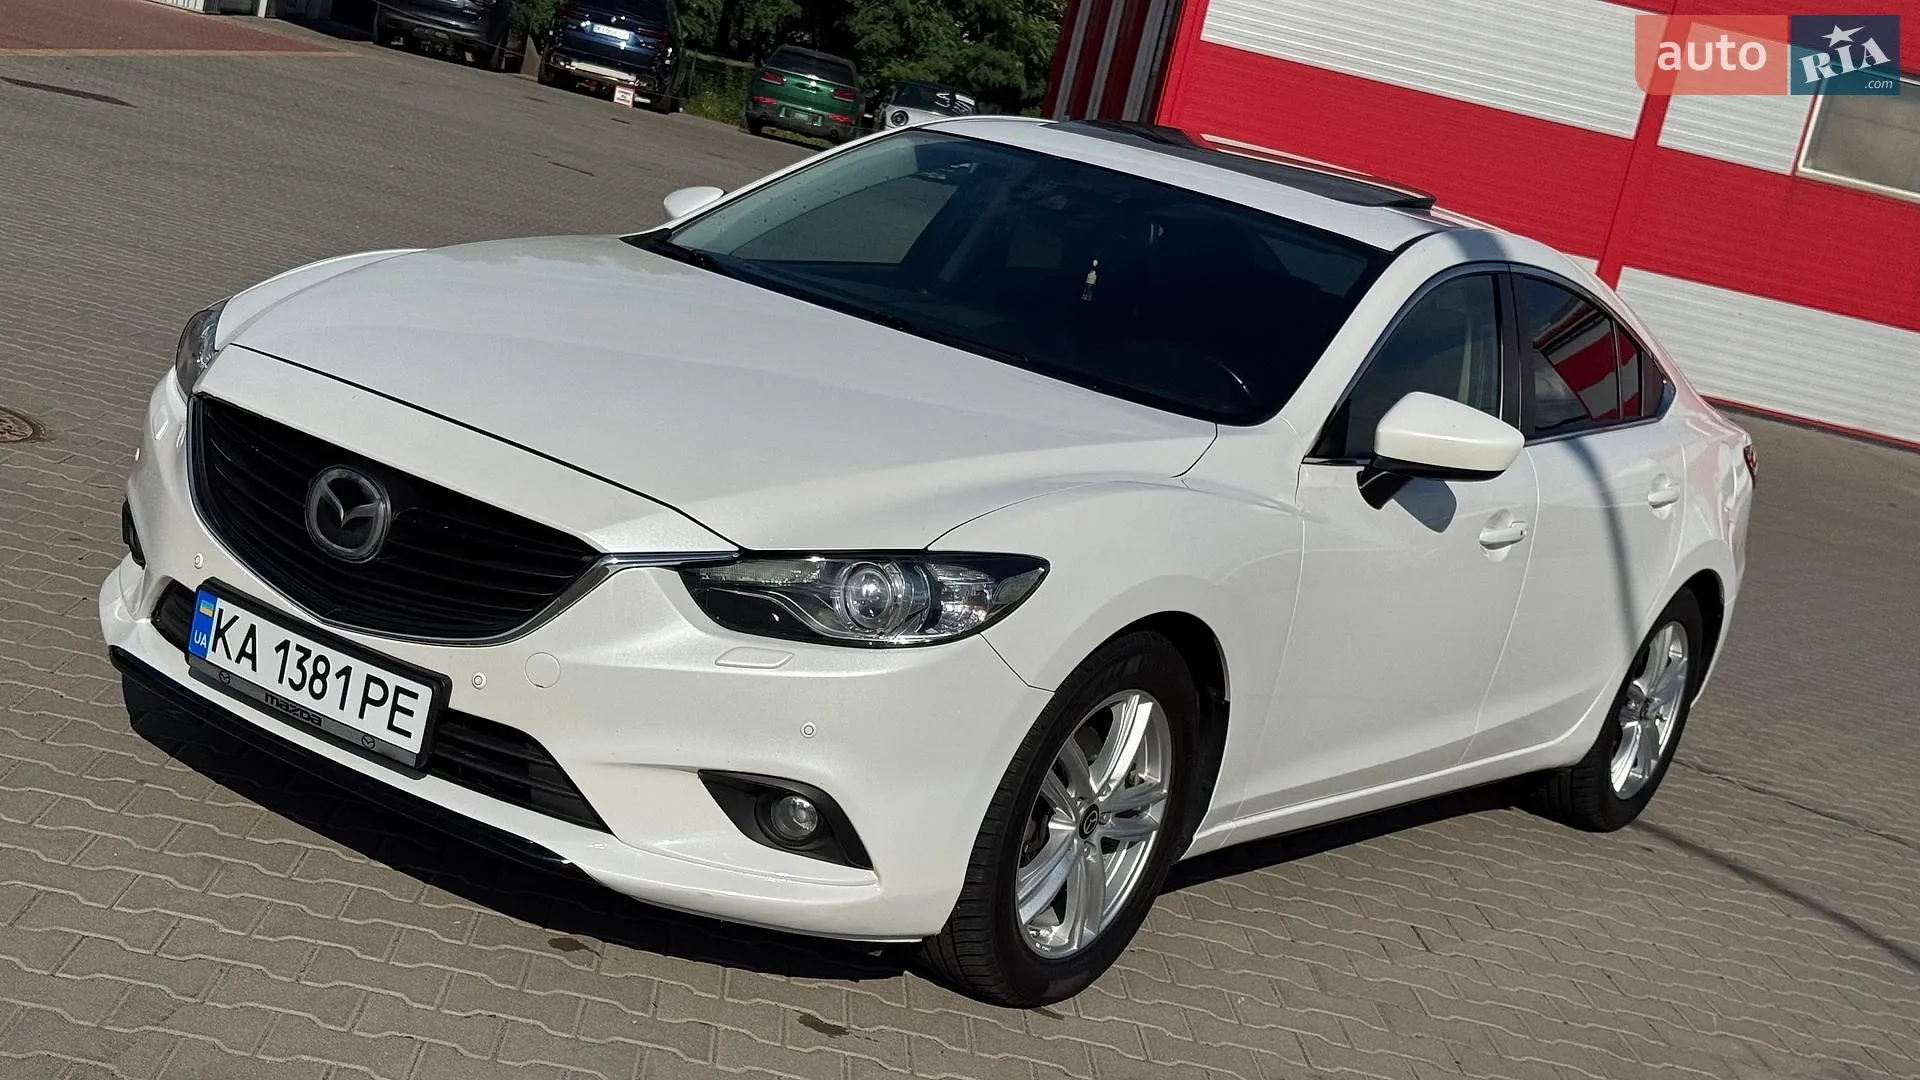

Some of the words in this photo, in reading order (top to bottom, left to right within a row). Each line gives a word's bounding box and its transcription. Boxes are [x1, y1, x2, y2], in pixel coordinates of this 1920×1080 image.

[194, 630, 207, 648] UA
[212, 607, 257, 672] KA
[274, 639, 353, 711] 1381
[358, 673, 419, 739] PE
